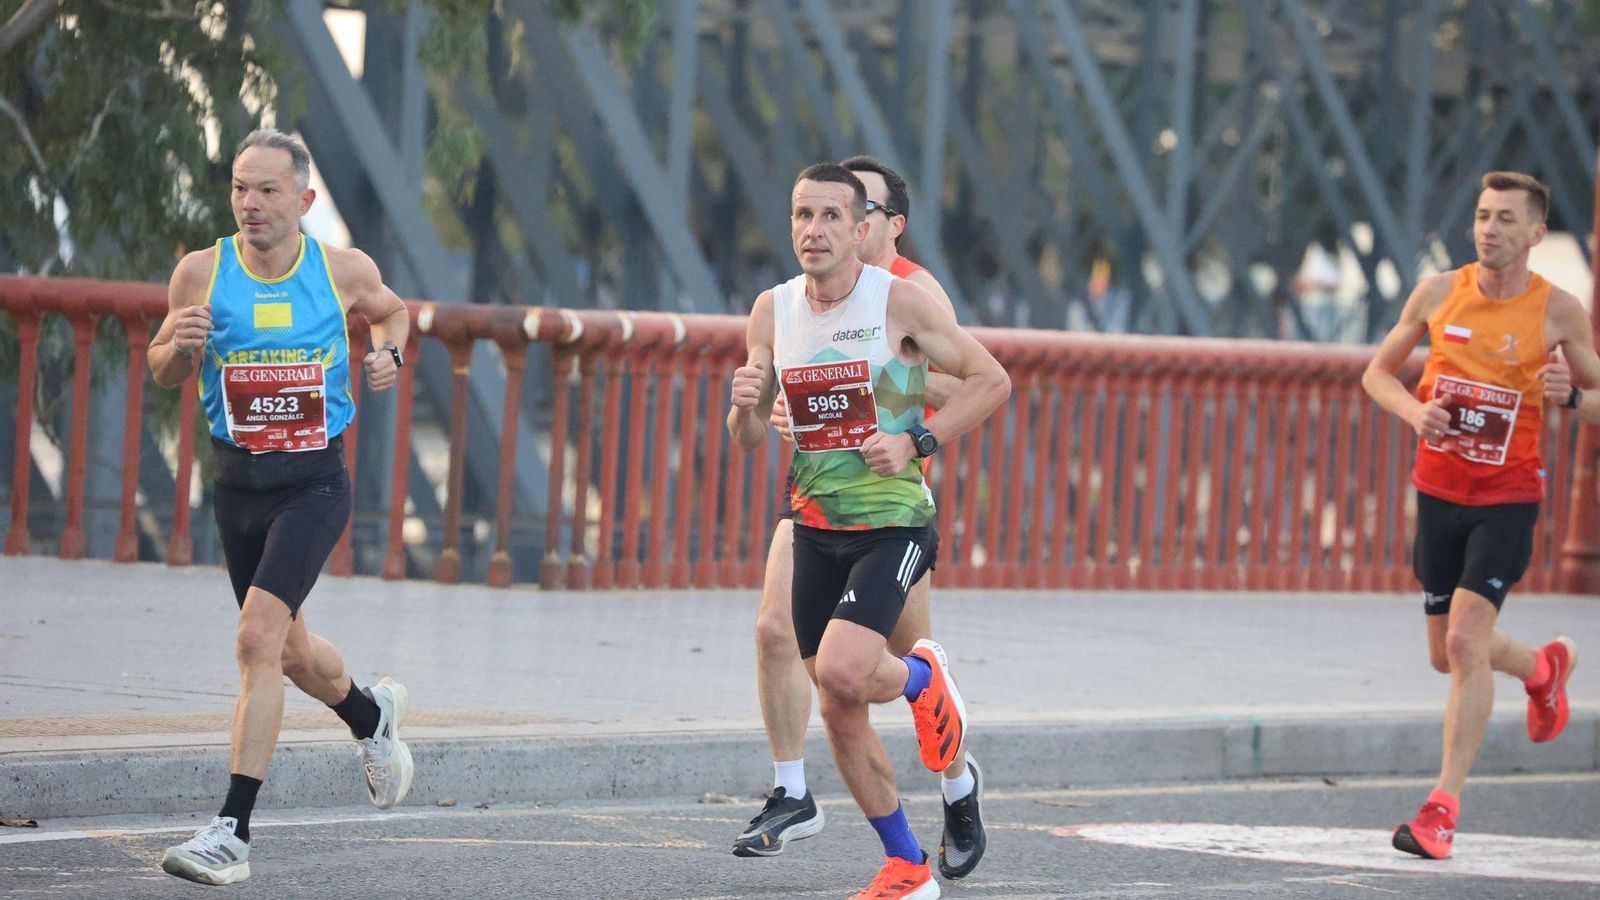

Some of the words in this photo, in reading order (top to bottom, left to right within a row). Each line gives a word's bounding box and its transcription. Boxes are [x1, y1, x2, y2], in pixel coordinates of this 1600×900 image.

[228, 349, 308, 364] BREAKING
[250, 365, 319, 382] GENERALI
[803, 364, 863, 382] GENERALI
[807, 394, 849, 413] 5963
[1457, 385, 1516, 405] GEERALI
[250, 396, 299, 413] 4523
[246, 414, 268, 422] ÁNGEL
[269, 413, 304, 421] GONZÁLEZ
[818, 411, 843, 420] NICOLAE
[1459, 407, 1485, 427] 186
